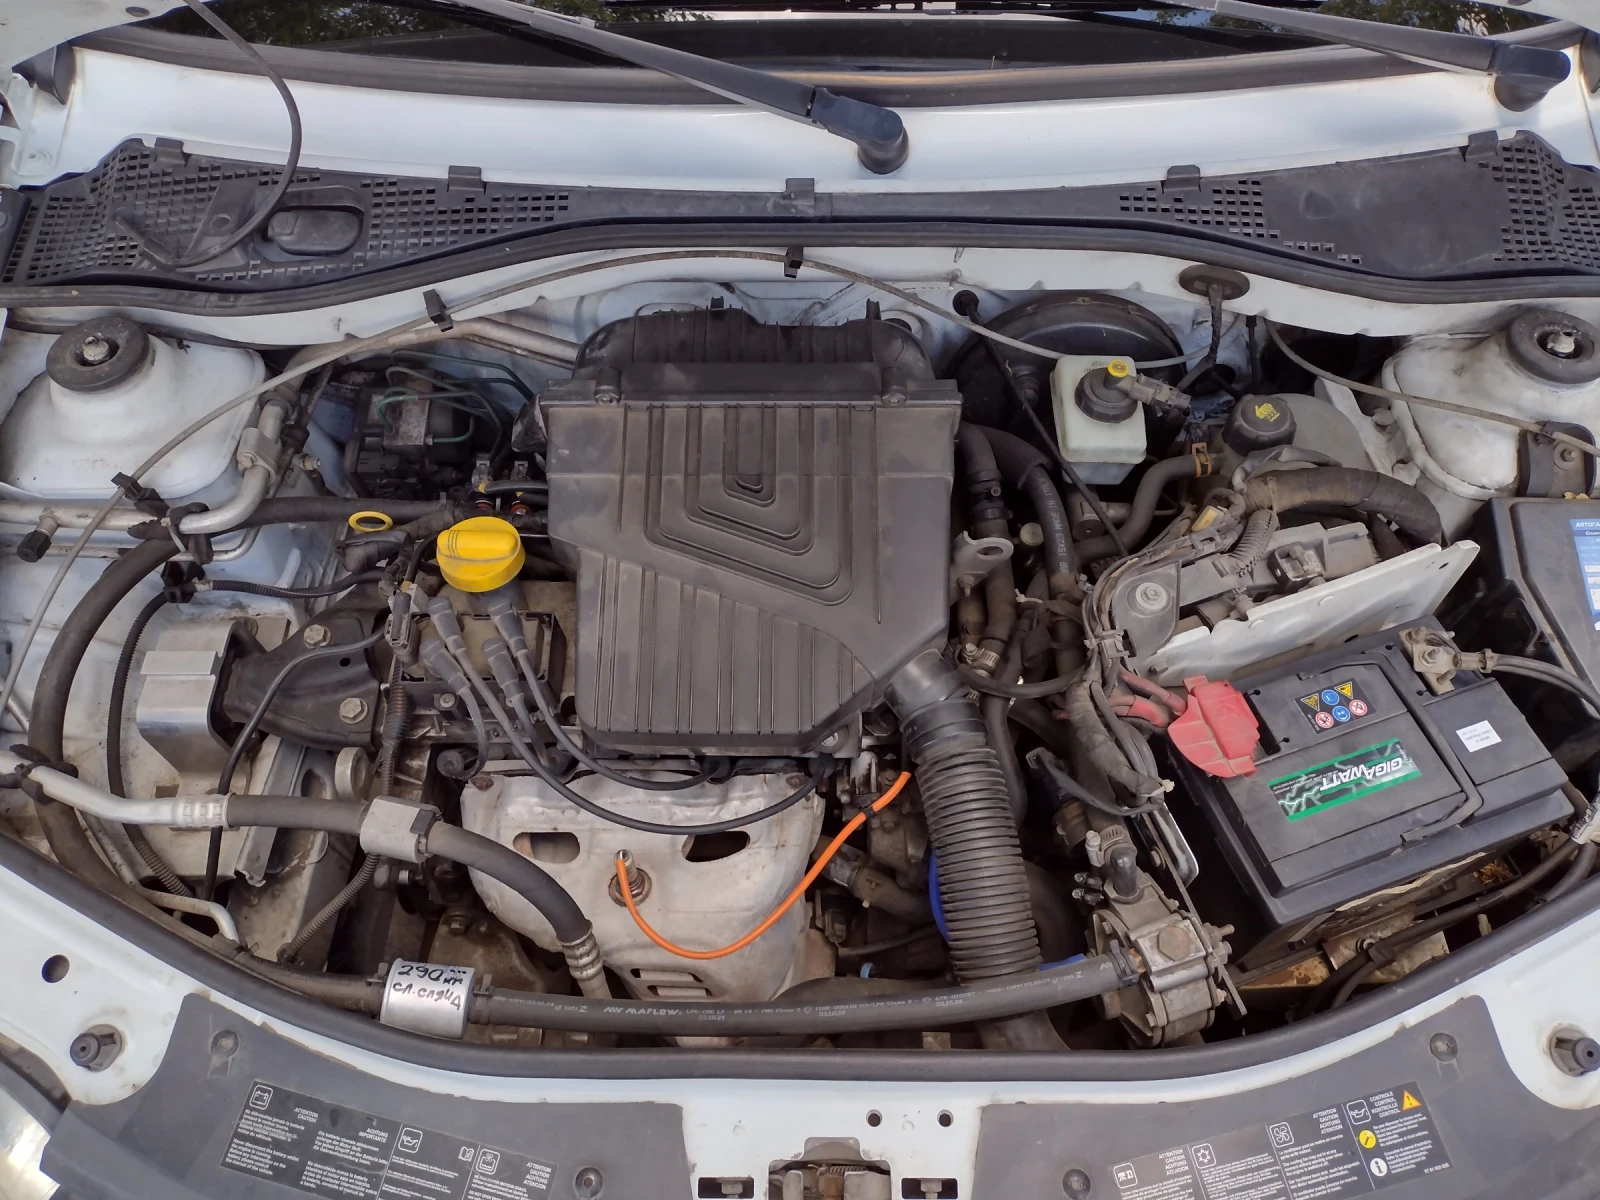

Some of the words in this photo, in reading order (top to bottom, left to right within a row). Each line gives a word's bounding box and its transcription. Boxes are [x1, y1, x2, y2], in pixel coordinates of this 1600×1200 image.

[1320, 757, 1403, 791] GIGAWATT
[398, 964, 444, 982] 290
[624, 1007, 678, 1015] MAFLOW
[296, 1114, 316, 1123] CAUTION
